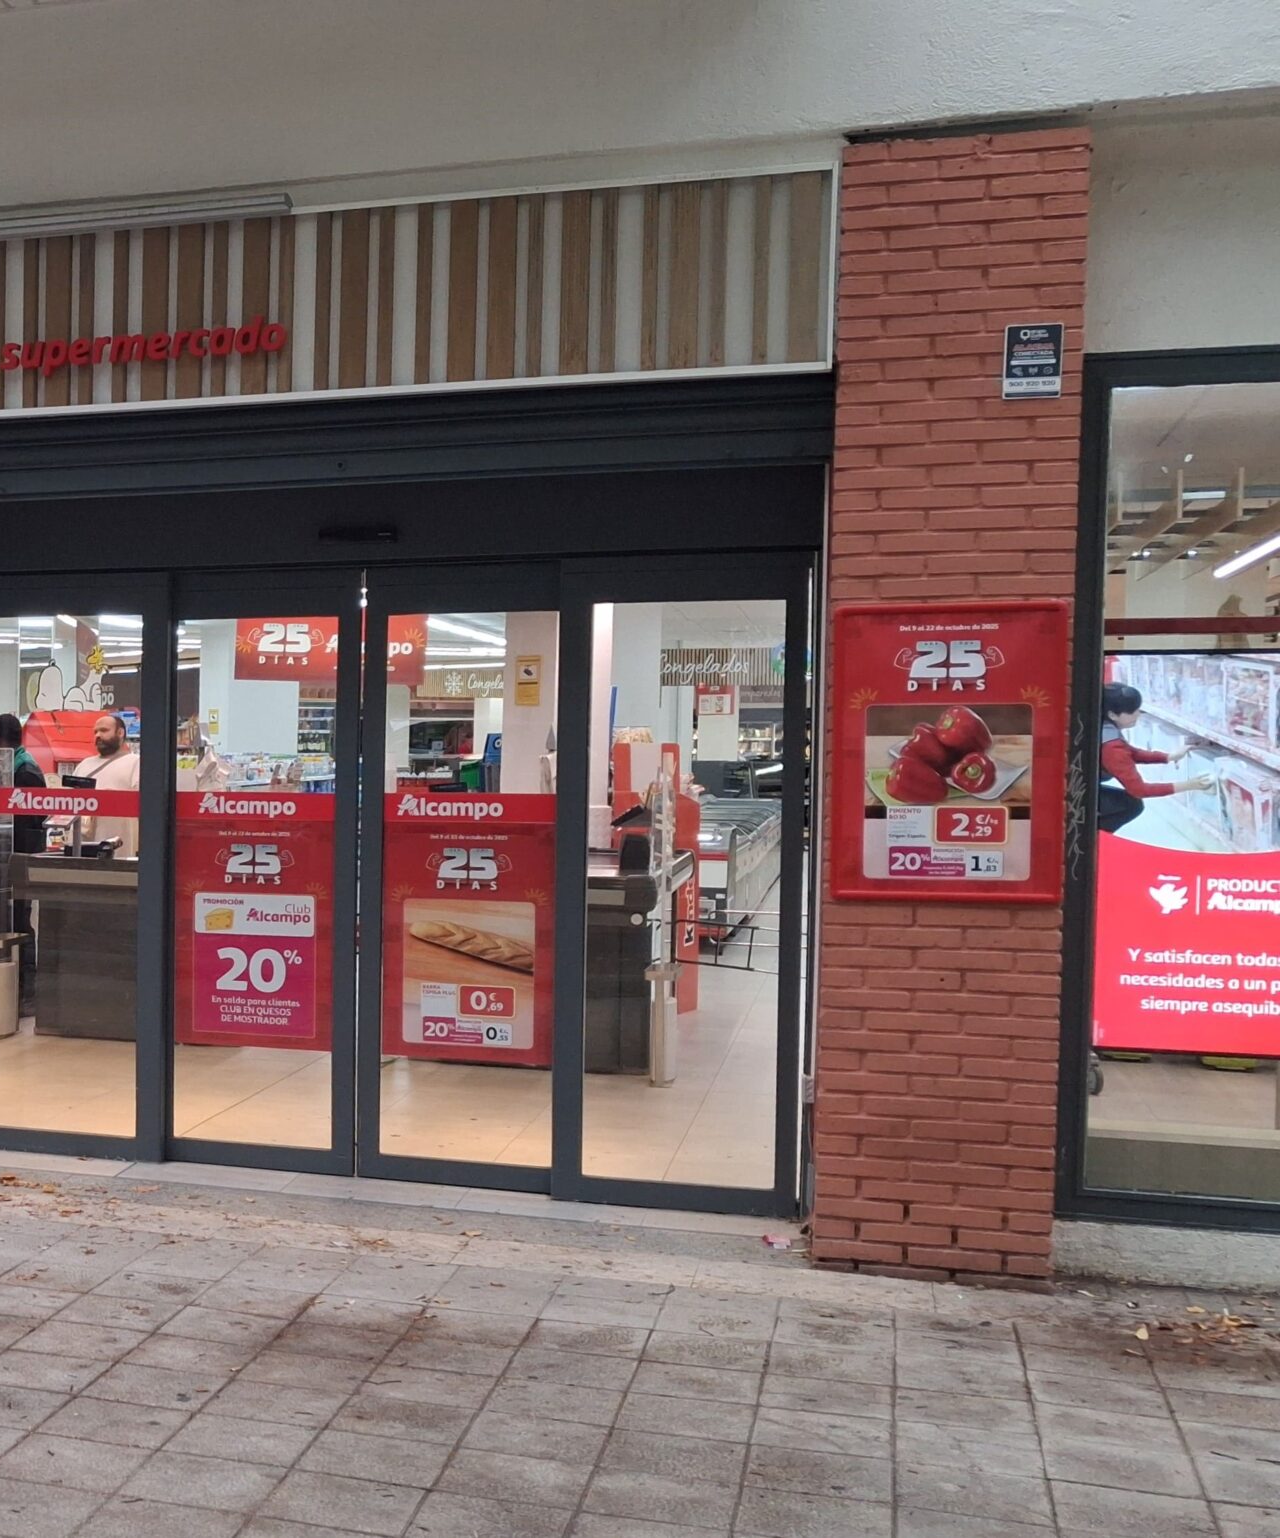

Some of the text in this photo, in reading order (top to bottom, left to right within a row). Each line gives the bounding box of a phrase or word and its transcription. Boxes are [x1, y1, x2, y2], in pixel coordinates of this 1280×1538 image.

[0, 315, 288, 377] supermercado
[257, 623, 311, 653] 25
[258, 655, 309, 665] DÍAS
[909, 640, 986, 678] 25
[660, 653, 749, 685] Congelados
[907, 678, 986, 691] DÍAS
[7, 788, 99, 813] Alcampo
[198, 793, 296, 818] Alcampo
[397, 794, 504, 820] Alcampo
[950, 813, 970, 837] 2
[226, 843, 281, 874] 25
[438, 848, 498, 879] 25
[890, 852, 930, 871] 20%
[971, 856, 982, 871] 1
[224, 873, 281, 884] DÍAS
[436, 878, 497, 890] DÍAS
[246, 908, 311, 925] Alcampo
[285, 903, 311, 914] Club
[1128, 947, 1141, 962] Y
[1144, 949, 1232, 965] satisfacen
[216, 947, 302, 993] 20%
[1120, 973, 1224, 989] necesidades
[1228, 978, 1239, 989] a
[1244, 979, 1267, 990] un
[212, 995, 300, 1007] En saldo para clientes
[220, 1005, 292, 1016] CLUB EN QUESOS
[470, 991, 487, 1011] 0
[1140, 995, 1209, 1015] siempre
[221, 1014, 288, 1026] DE MOSTRADOR
[486, 1026, 497, 1040] 0
